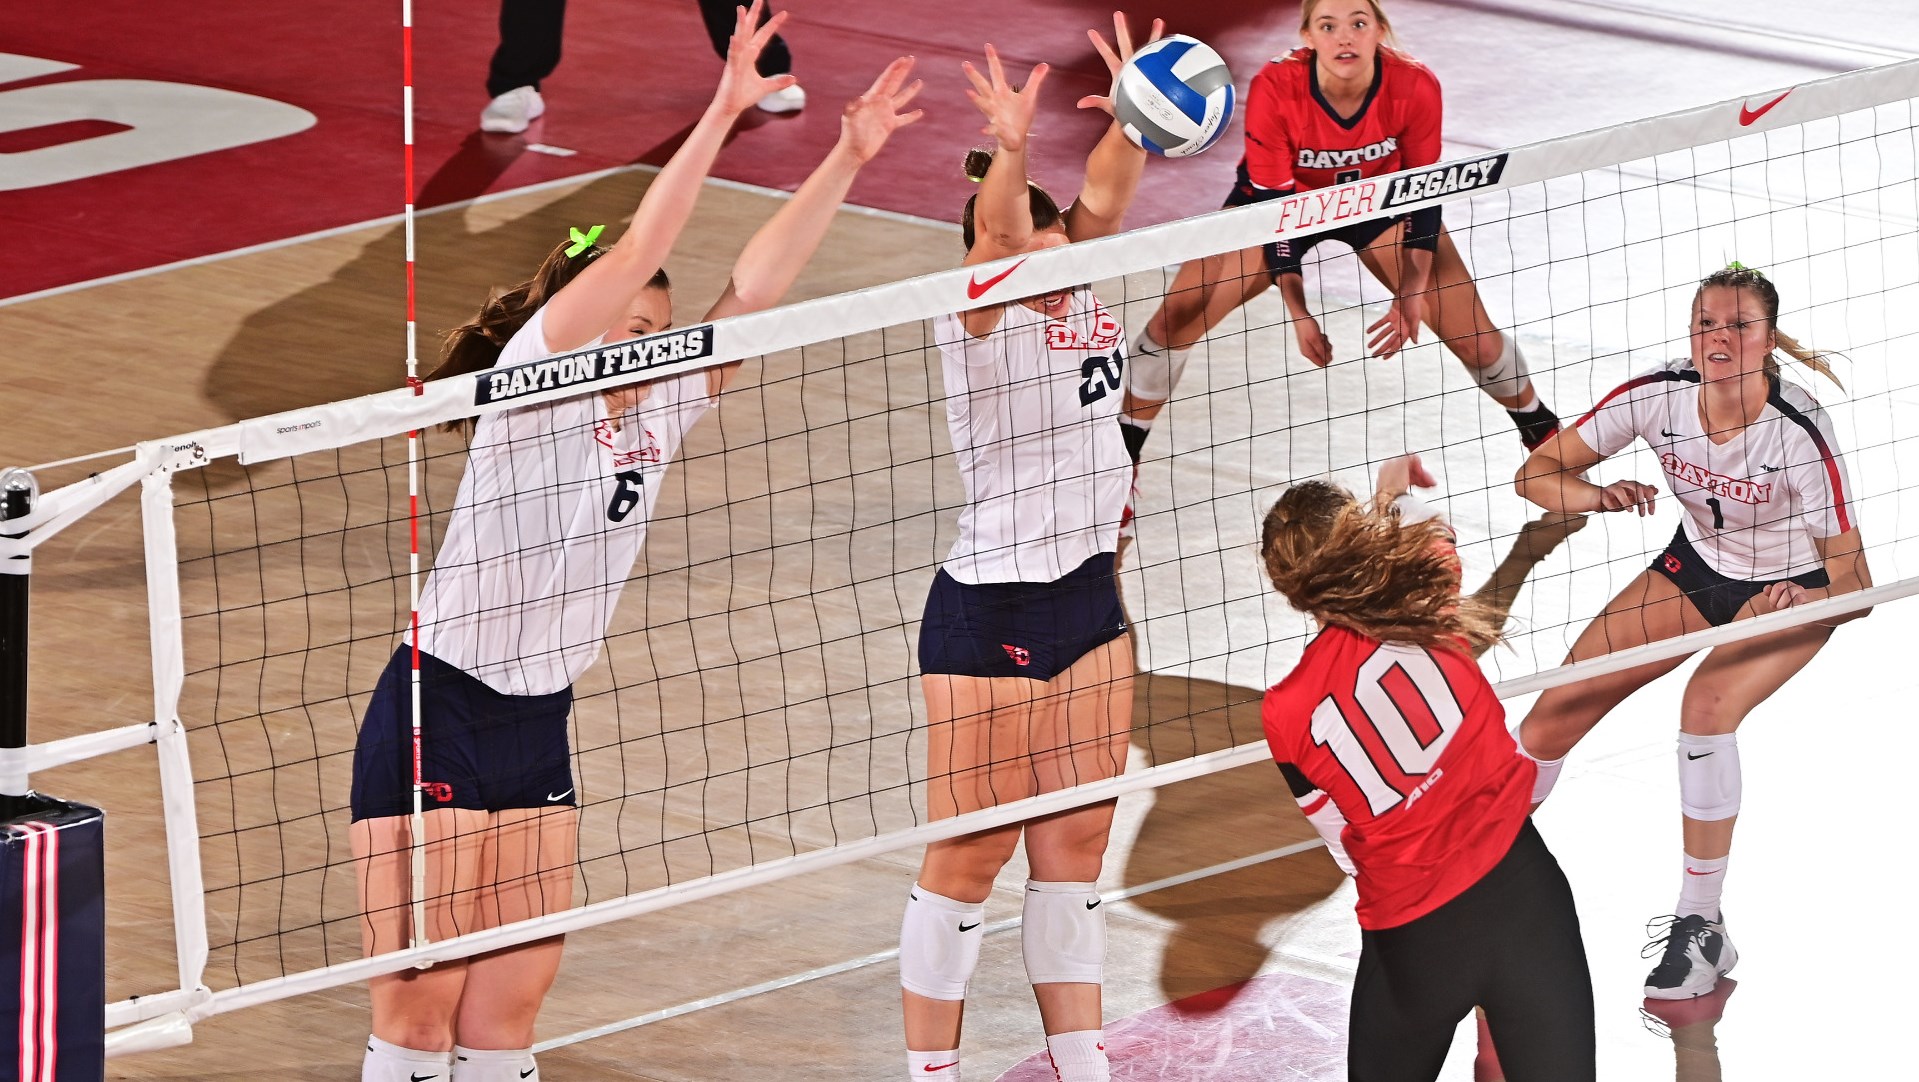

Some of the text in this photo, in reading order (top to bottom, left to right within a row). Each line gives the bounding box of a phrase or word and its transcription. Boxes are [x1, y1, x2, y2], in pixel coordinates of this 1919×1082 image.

[1297, 137, 1398, 169] DAYTON
[1275, 182, 1377, 233] FLYER
[1389, 158, 1498, 206] LEGACY
[489, 330, 704, 400] DAYTON FLYERS
[1079, 346, 1124, 408] 20
[171, 441, 197, 452] enoh
[276, 420, 321, 435] sports imports
[606, 470, 644, 522] 6
[1660, 452, 1771, 505] DAYTON
[1705, 498, 1724, 529] 1
[1309, 639, 1465, 818] 10
